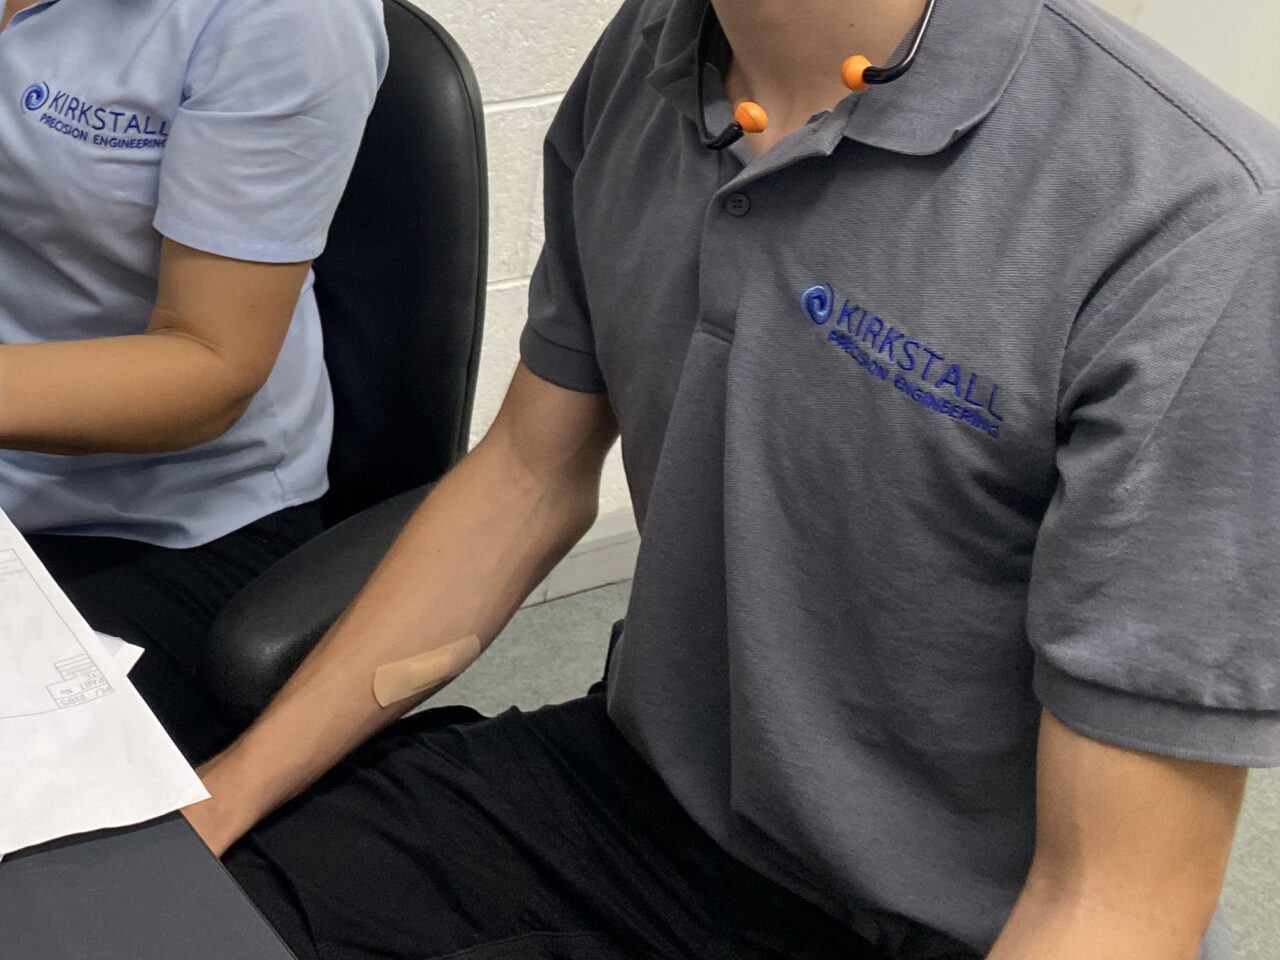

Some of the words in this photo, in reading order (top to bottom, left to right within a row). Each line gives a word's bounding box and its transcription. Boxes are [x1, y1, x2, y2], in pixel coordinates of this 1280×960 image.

[39, 113, 89, 142] PRECISION
[48, 90, 170, 137] KIRKSTALL
[836, 298, 1004, 422] KIRKSTALL
